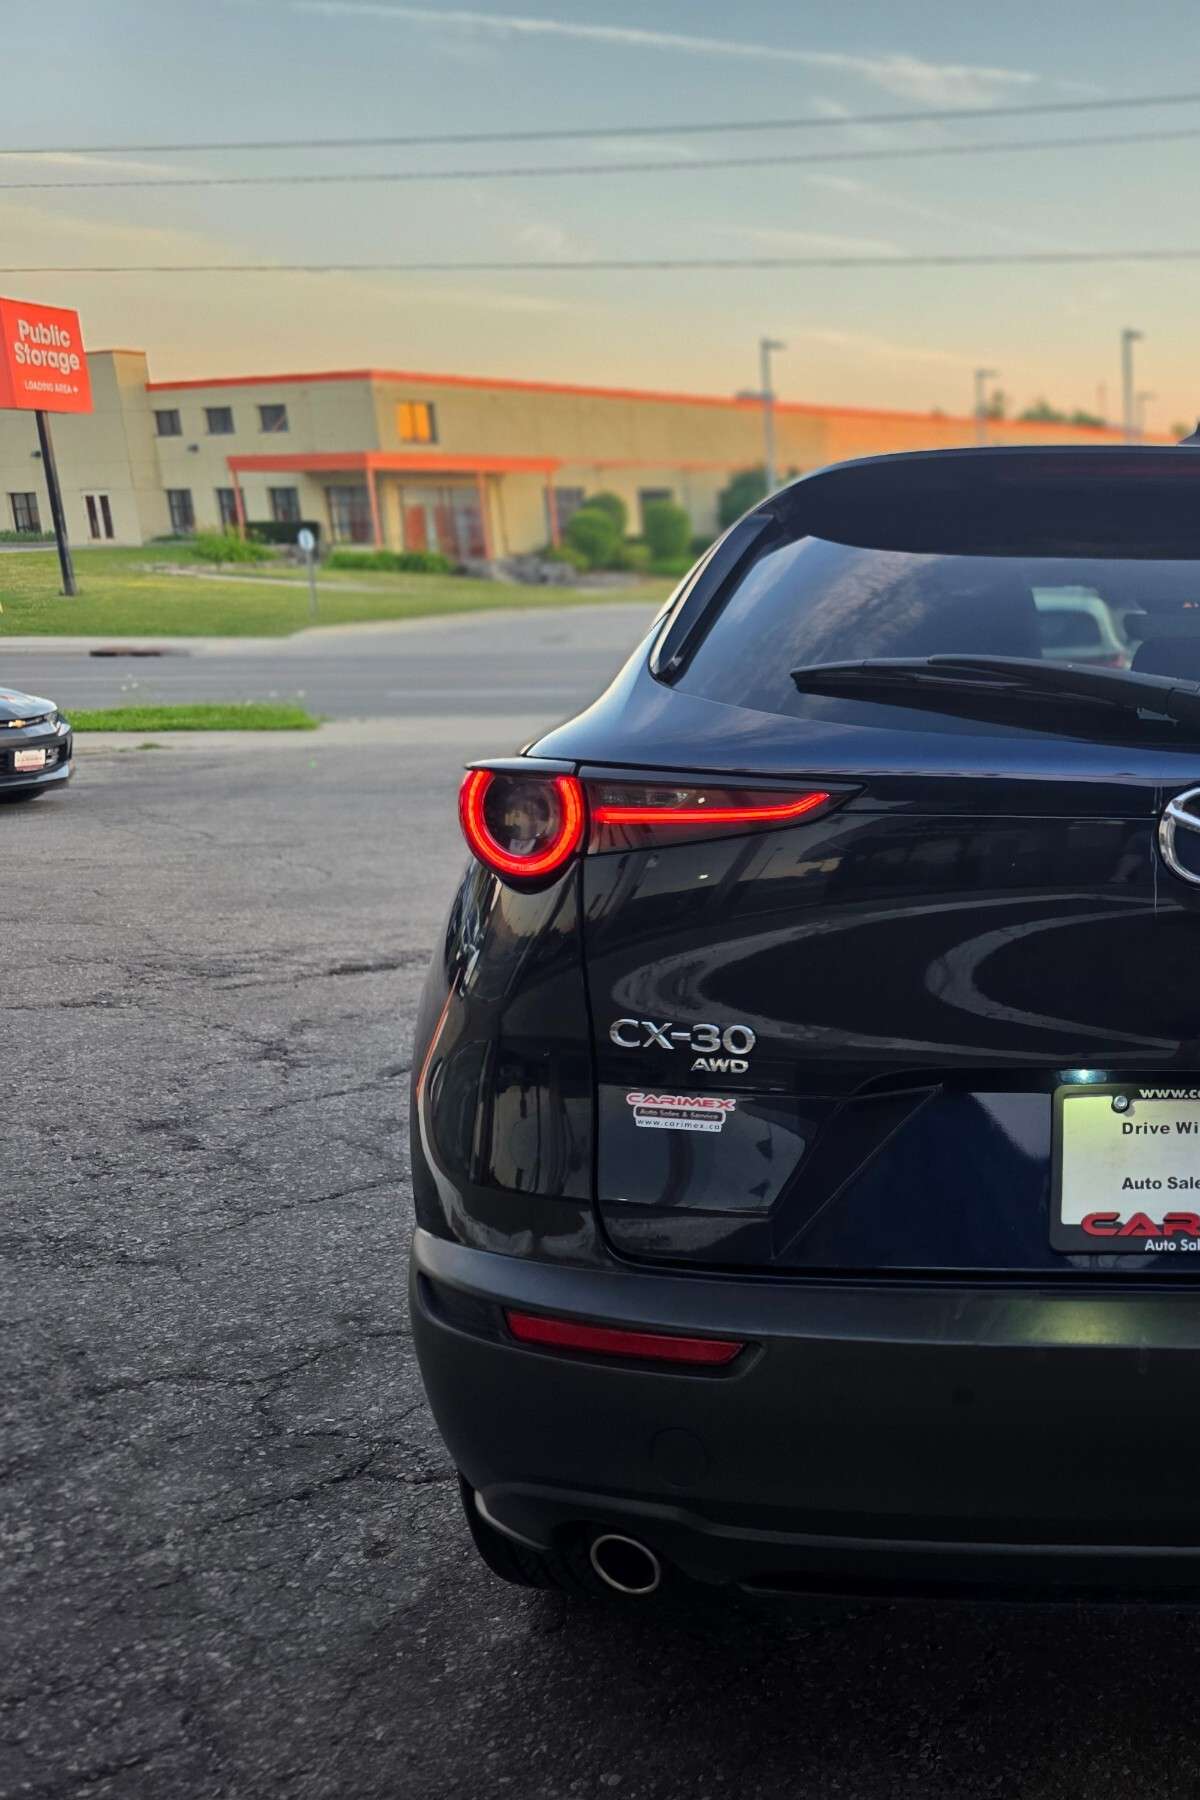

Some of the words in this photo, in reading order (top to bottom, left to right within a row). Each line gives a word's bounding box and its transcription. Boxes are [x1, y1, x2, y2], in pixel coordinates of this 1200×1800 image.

[17, 319, 71, 349] Public
[14, 341, 80, 375] Storage
[55, 383, 73, 395] AREA
[609, 1018, 756, 1055] CX-30
[690, 1057, 749, 1074] AWD
[627, 1093, 735, 1110] CARIMEX
[1122, 1121, 1171, 1135] Drive
[1122, 1176, 1162, 1190] Auto
[1144, 1238, 1177, 1252] Auto
